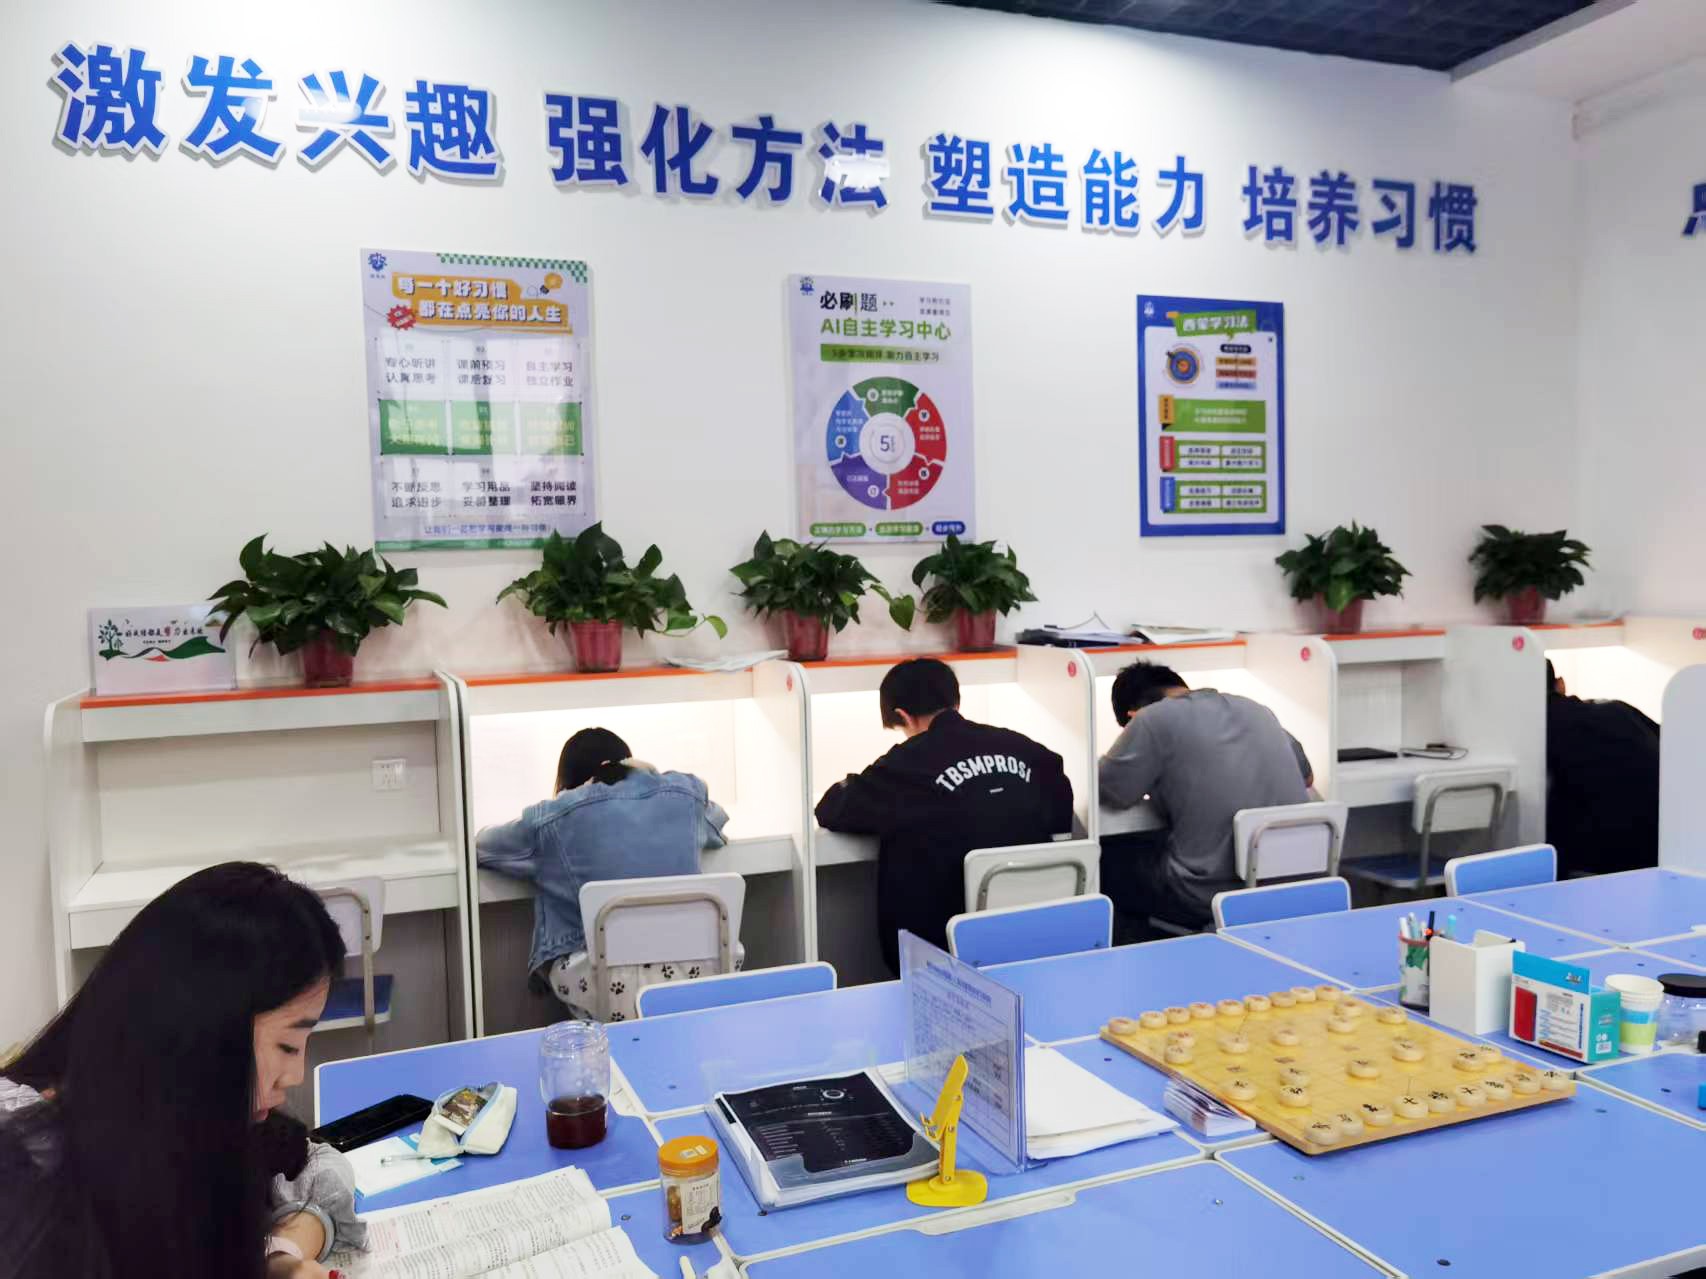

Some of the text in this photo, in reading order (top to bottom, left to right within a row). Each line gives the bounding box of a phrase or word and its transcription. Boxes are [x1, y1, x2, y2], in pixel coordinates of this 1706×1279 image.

[54, 42, 1479, 253] 激发兴趣 强化方法 塑造能力 培养习惯
[397, 277, 509, 300] 每一个好习惯
[418, 301, 562, 323] 都在点亮你的人生
[819, 290, 878, 313] 必刷题
[820, 317, 952, 341] AI自主学习中心
[935, 754, 1032, 792] TBSMPROSI
